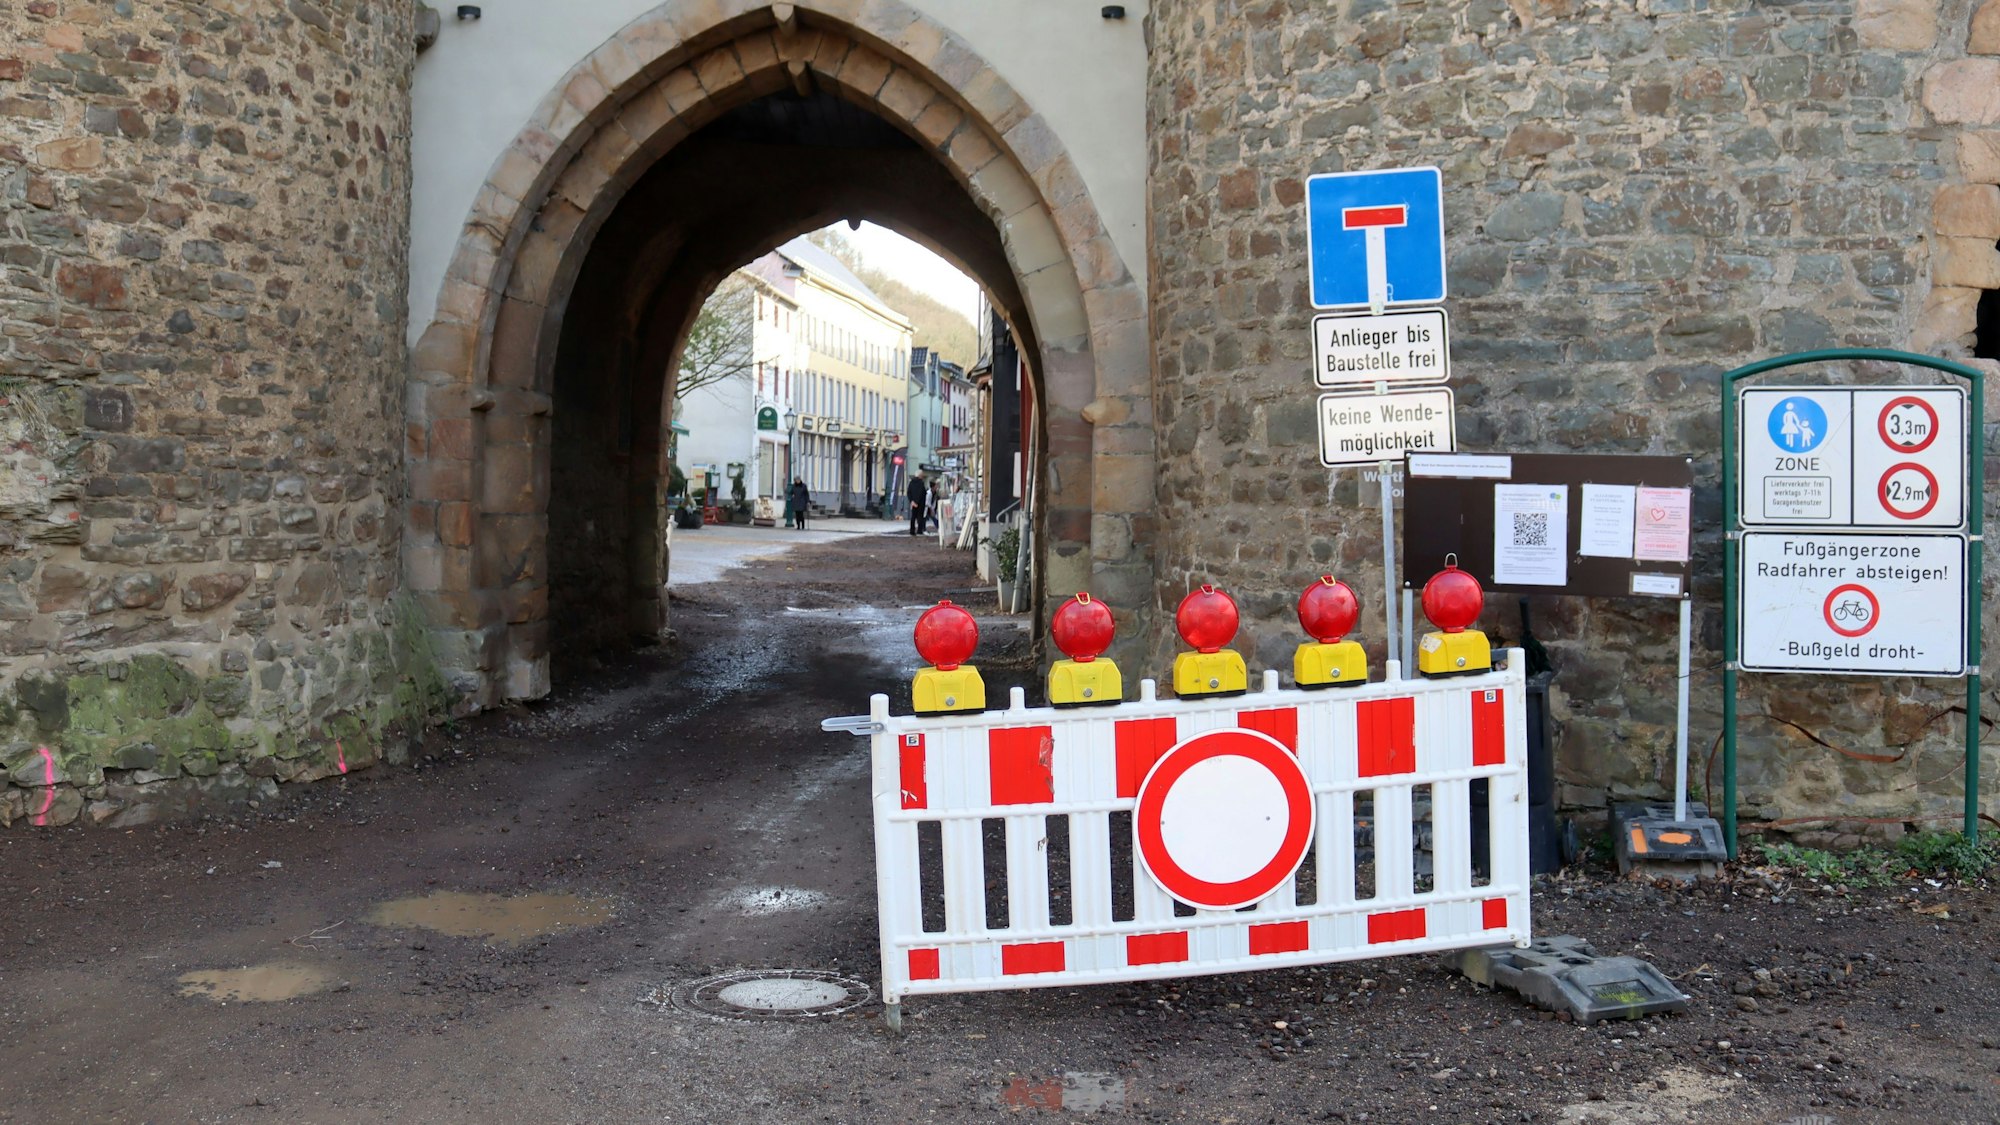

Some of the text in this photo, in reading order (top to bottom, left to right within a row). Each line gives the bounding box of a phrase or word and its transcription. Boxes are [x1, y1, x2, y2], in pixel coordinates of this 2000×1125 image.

[1330, 324, 1431, 350] Anlieger bis
[1327, 348, 1436, 372] Baustelle frei
[1329, 402, 1443, 426] keine Wende-
[1340, 430, 1435, 455] möglichkeit
[1775, 457, 1820, 471] ZONE
[1770, 480, 1825, 488] Lieferverkehr frei
[1774, 489, 1802, 498] werktags
[1772, 498, 1822, 507] Garagenbenutzer
[1784, 541, 1921, 561] Fußgängerzone
[1757, 562, 1948, 584] Radfahrer absteigen!
[1779, 641, 1924, 661] -Bußgeld droht-
